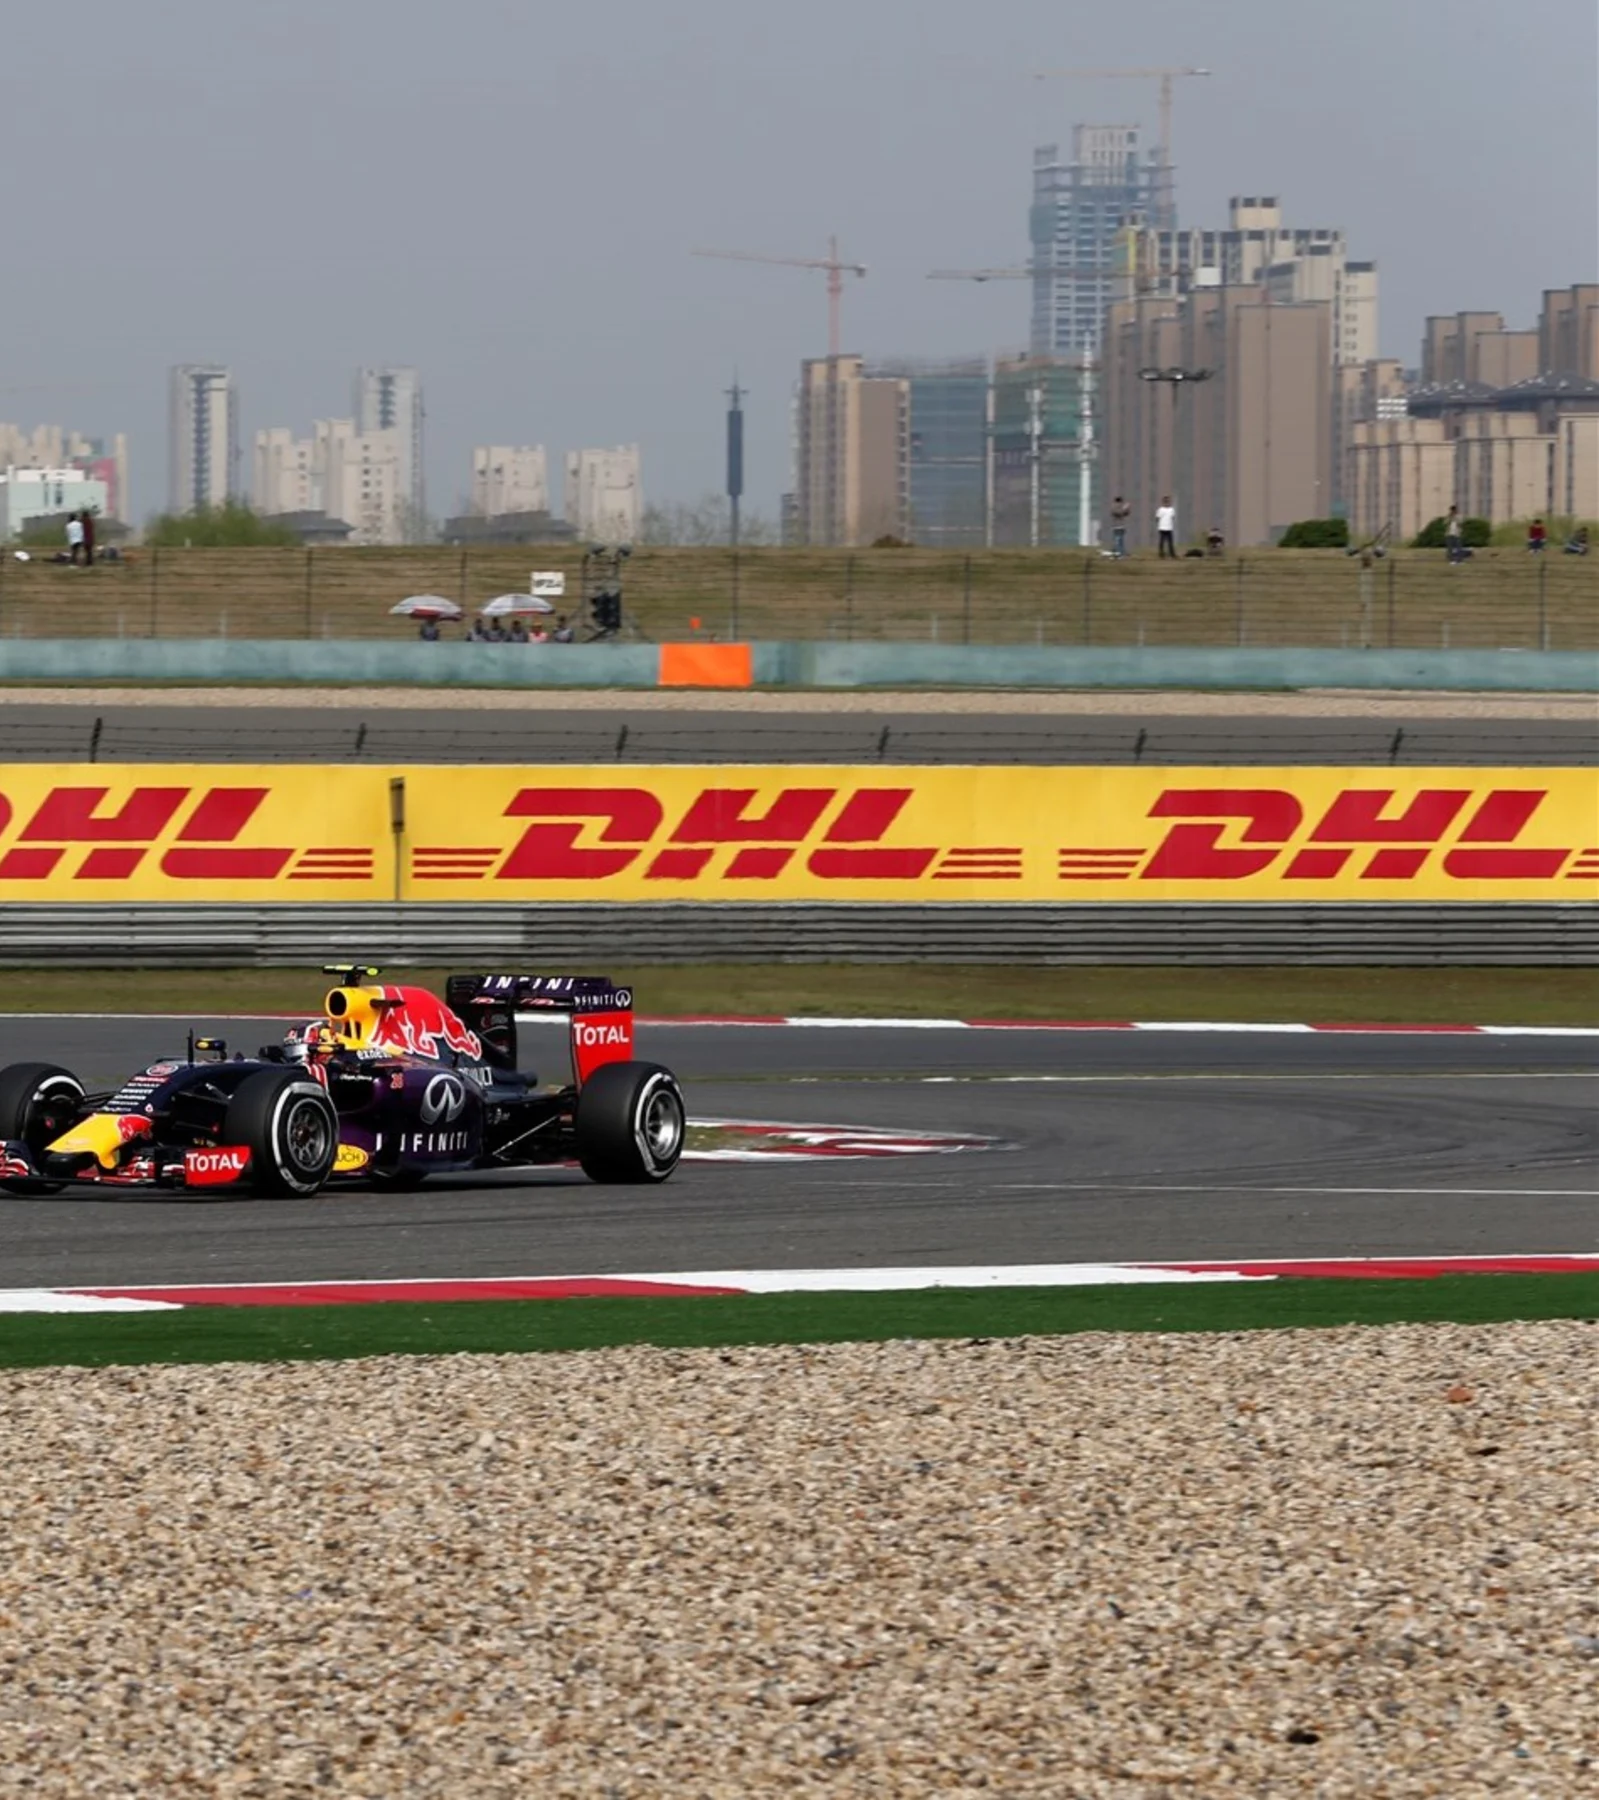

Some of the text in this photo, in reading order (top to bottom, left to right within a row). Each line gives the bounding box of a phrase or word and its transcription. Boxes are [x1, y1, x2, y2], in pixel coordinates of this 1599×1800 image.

[494, 788, 940, 879] DHL
[1139, 788, 1573, 880] DHL
[573, 1022, 630, 1046] TOTAL
[185, 1153, 243, 1172] TOTAL
